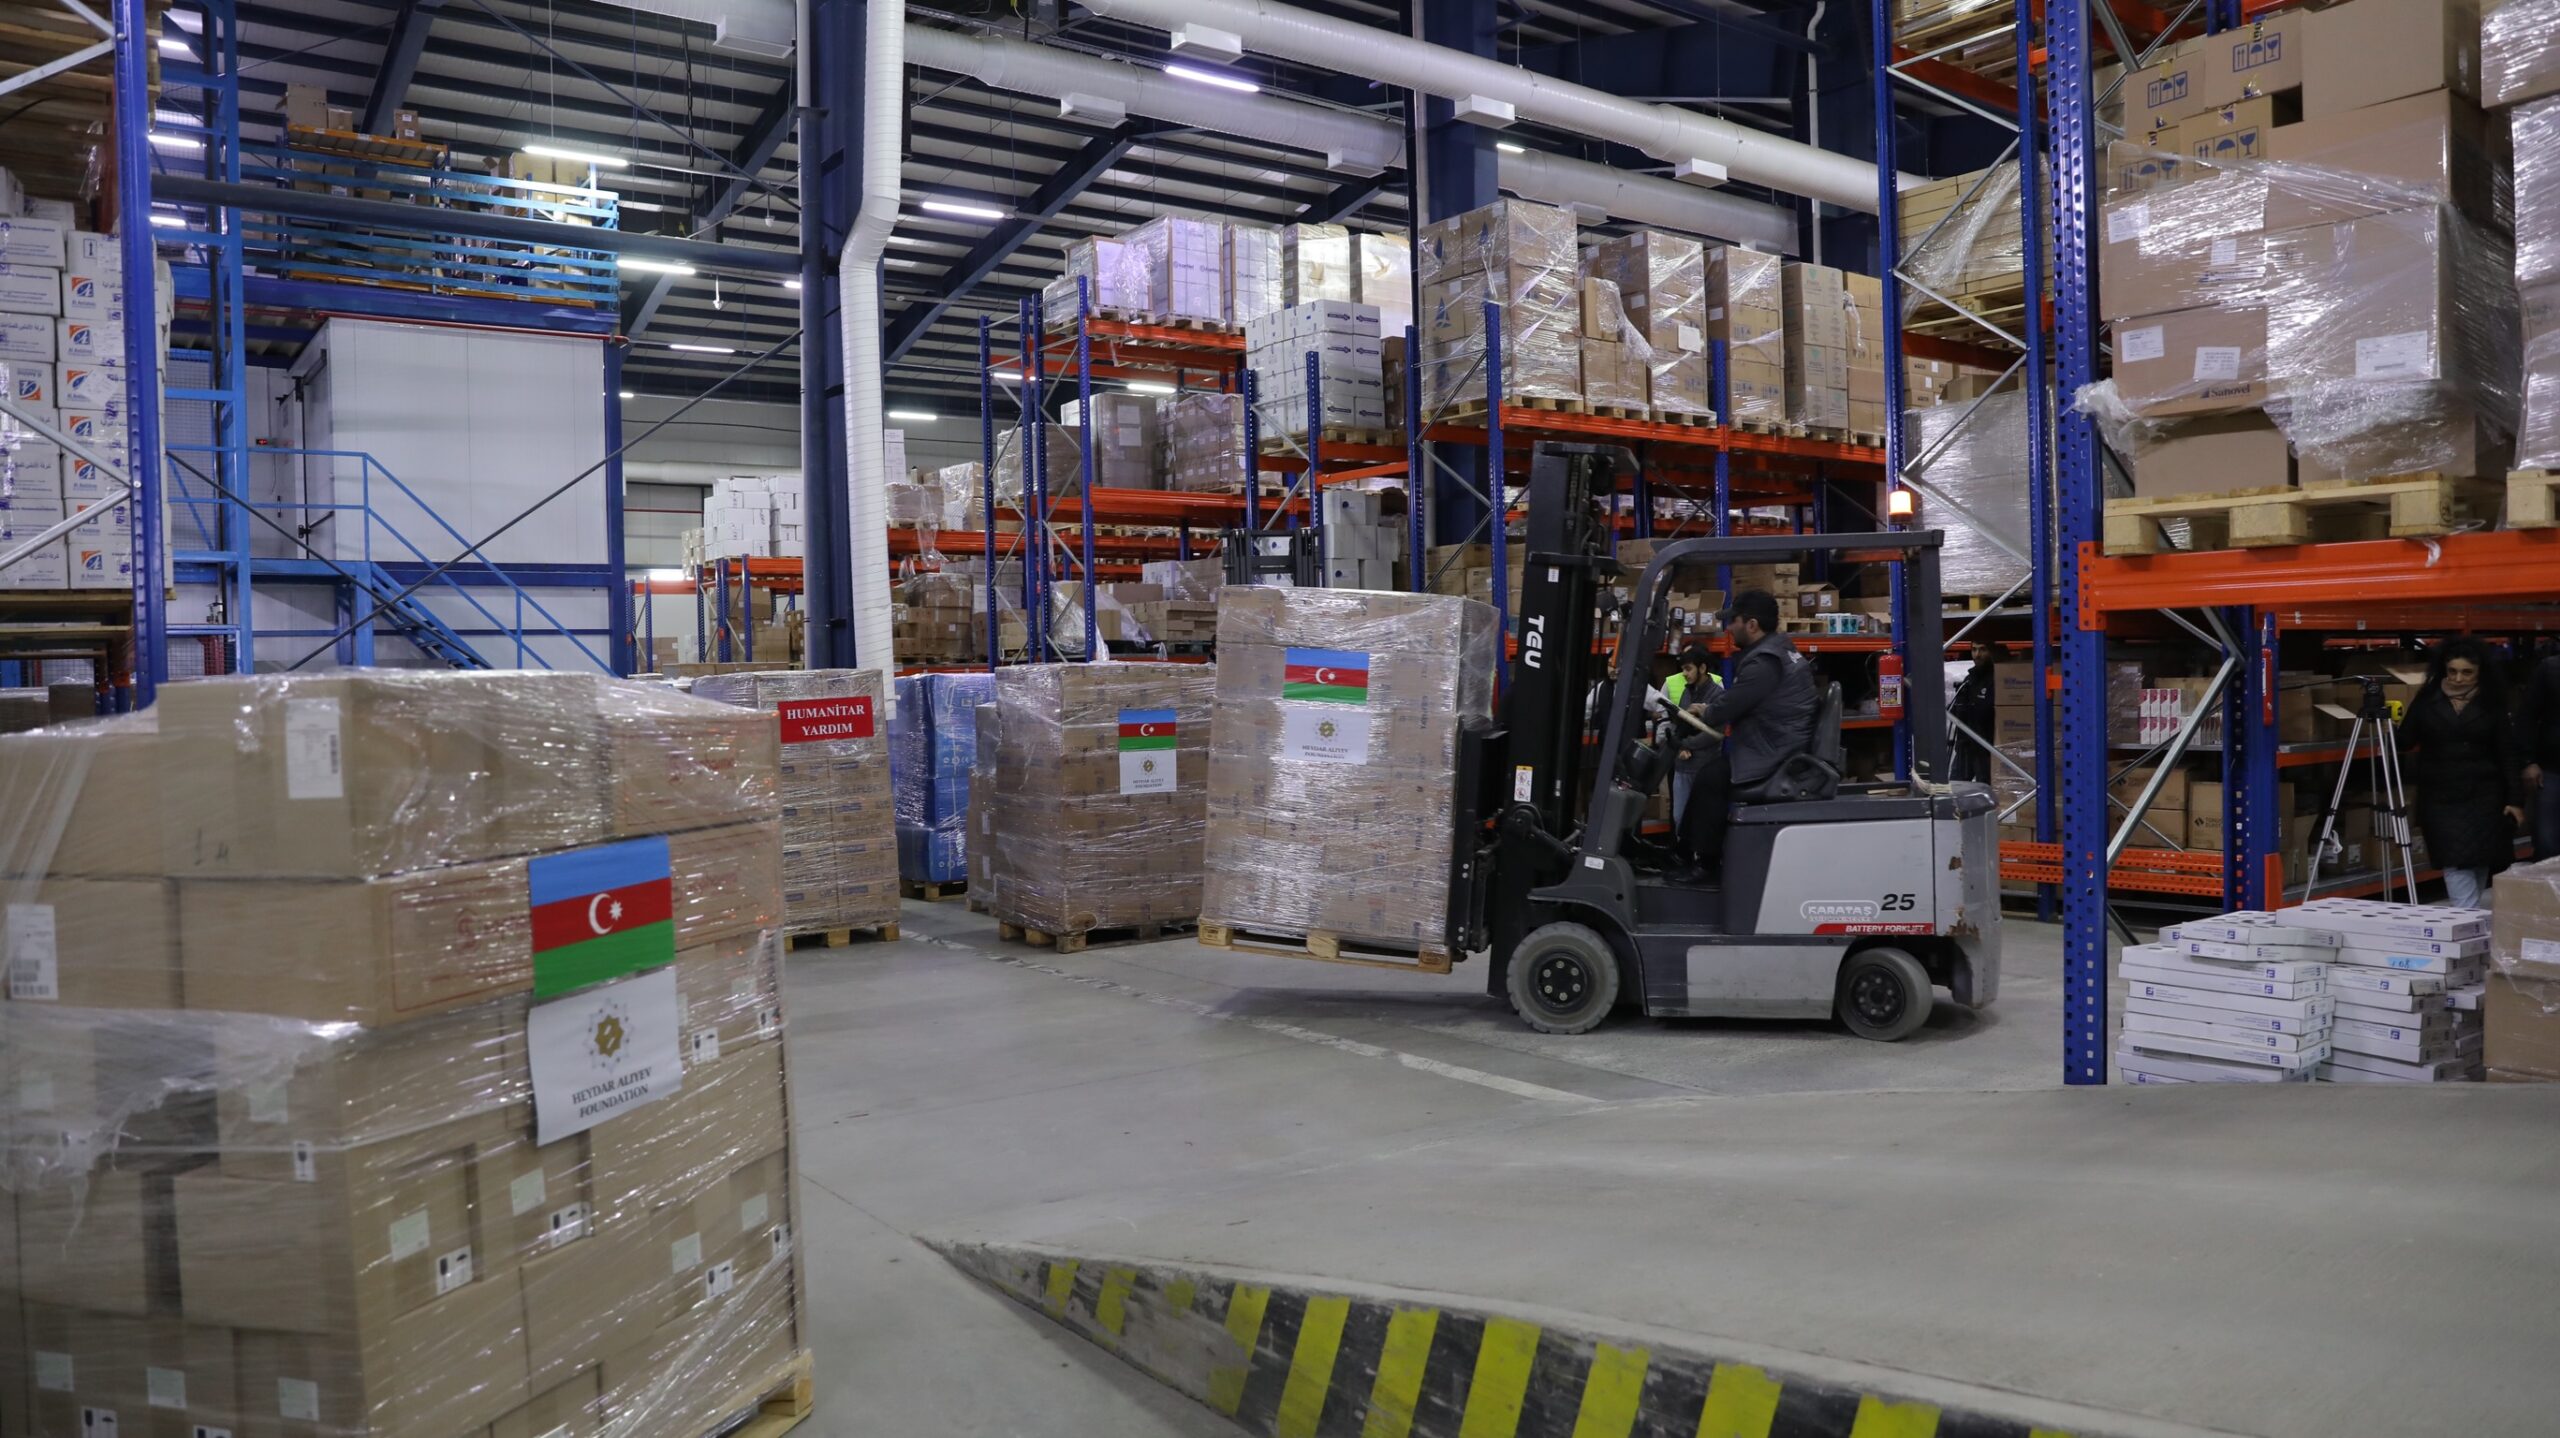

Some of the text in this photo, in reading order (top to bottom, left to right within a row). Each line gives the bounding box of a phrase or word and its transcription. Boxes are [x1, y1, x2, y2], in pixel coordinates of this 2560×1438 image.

[2210, 383, 2250, 397] Sanovel
[786, 703, 865, 720] HUMANİTAR
[801, 722, 853, 736] YARDIM
[1880, 893, 1916, 911] 25
[1808, 906, 1873, 917] KARATAŞ
[1845, 924, 1884, 933] BATTERY
[571, 1066, 652, 1105] HEYDAR ALIYEV
[578, 1084, 649, 1118] FOUNDATION
